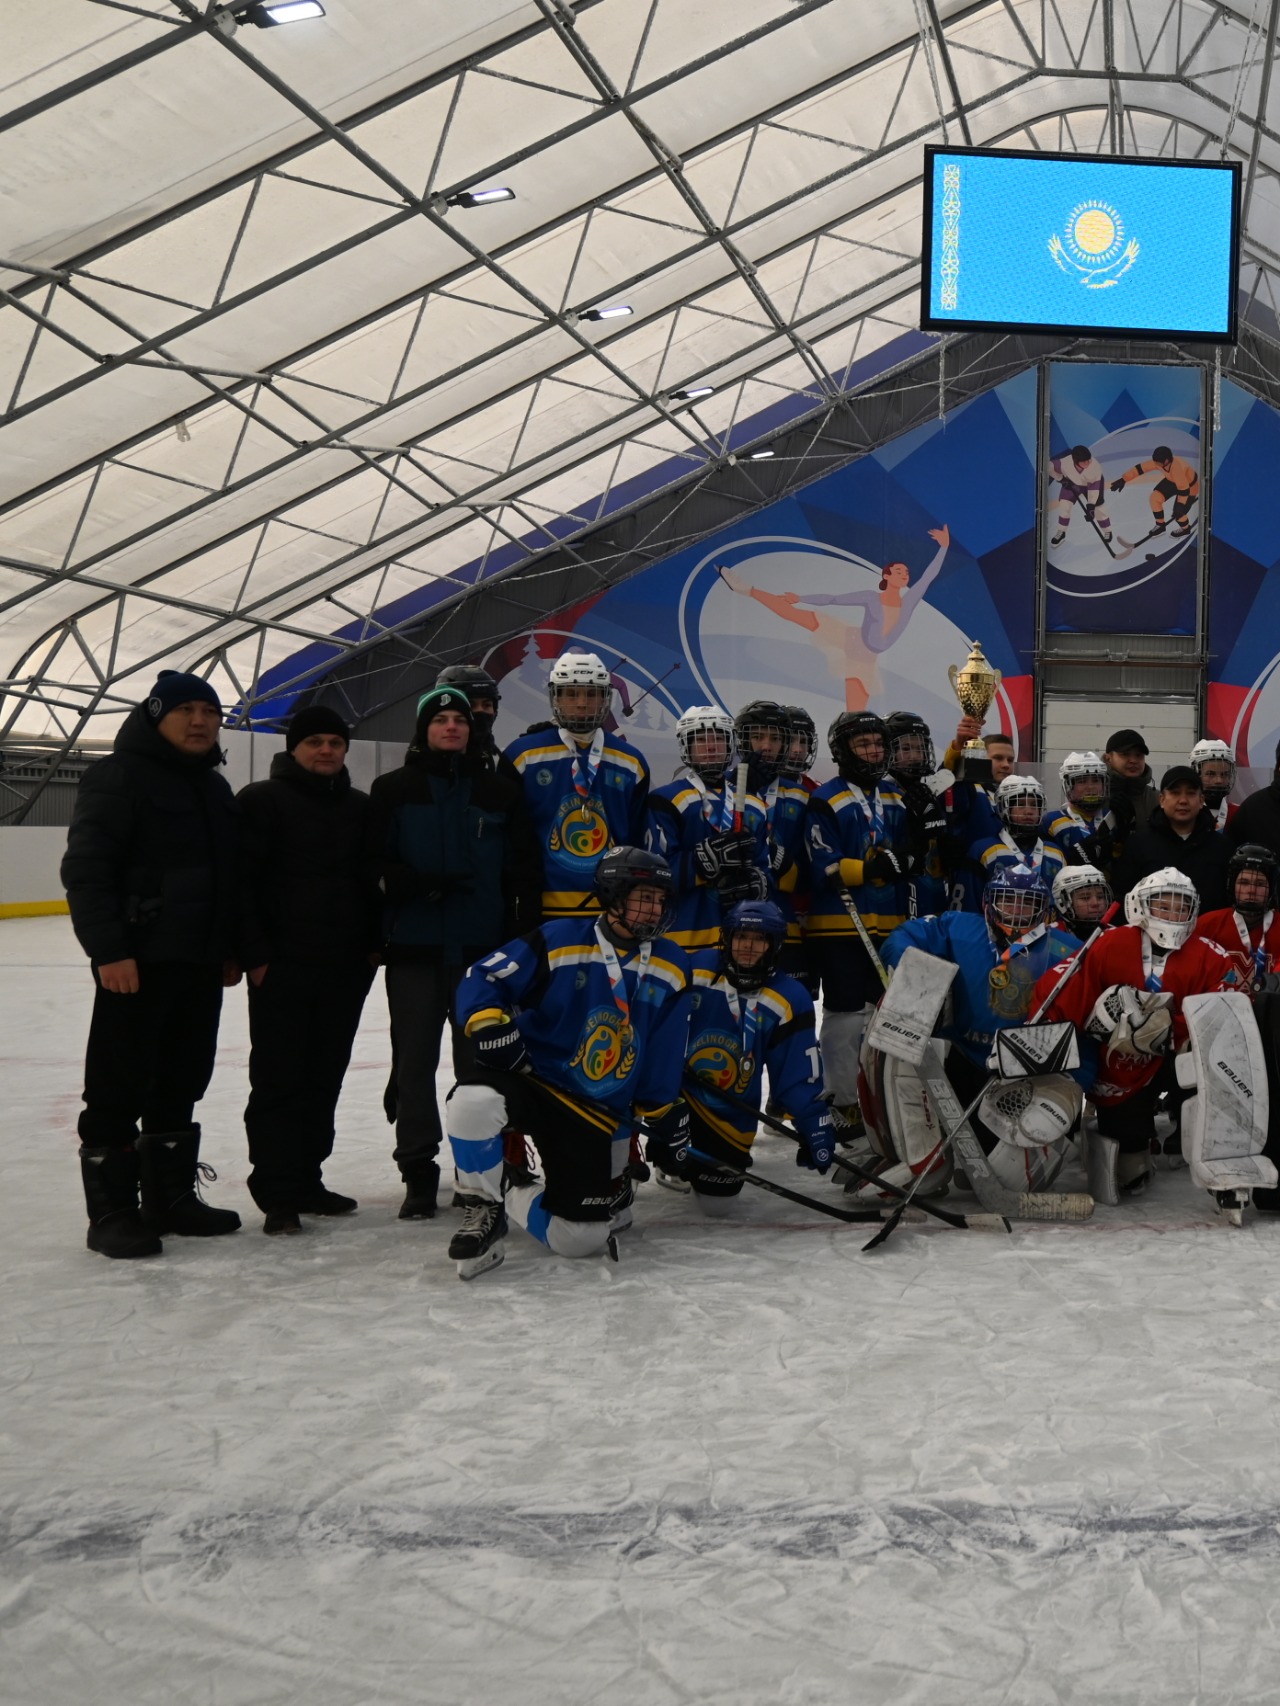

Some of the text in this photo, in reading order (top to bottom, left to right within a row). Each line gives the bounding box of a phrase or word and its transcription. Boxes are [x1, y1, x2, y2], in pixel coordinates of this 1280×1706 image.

[656, 869, 672, 877] CCM
[882, 1021, 922, 1041] BAUER
[1009, 1033, 1043, 1065] BAUER
[1217, 1061, 1253, 1098] BAUER
[1039, 1102, 1068, 1126] BAUER
[927, 1079, 990, 1179] BAUER
